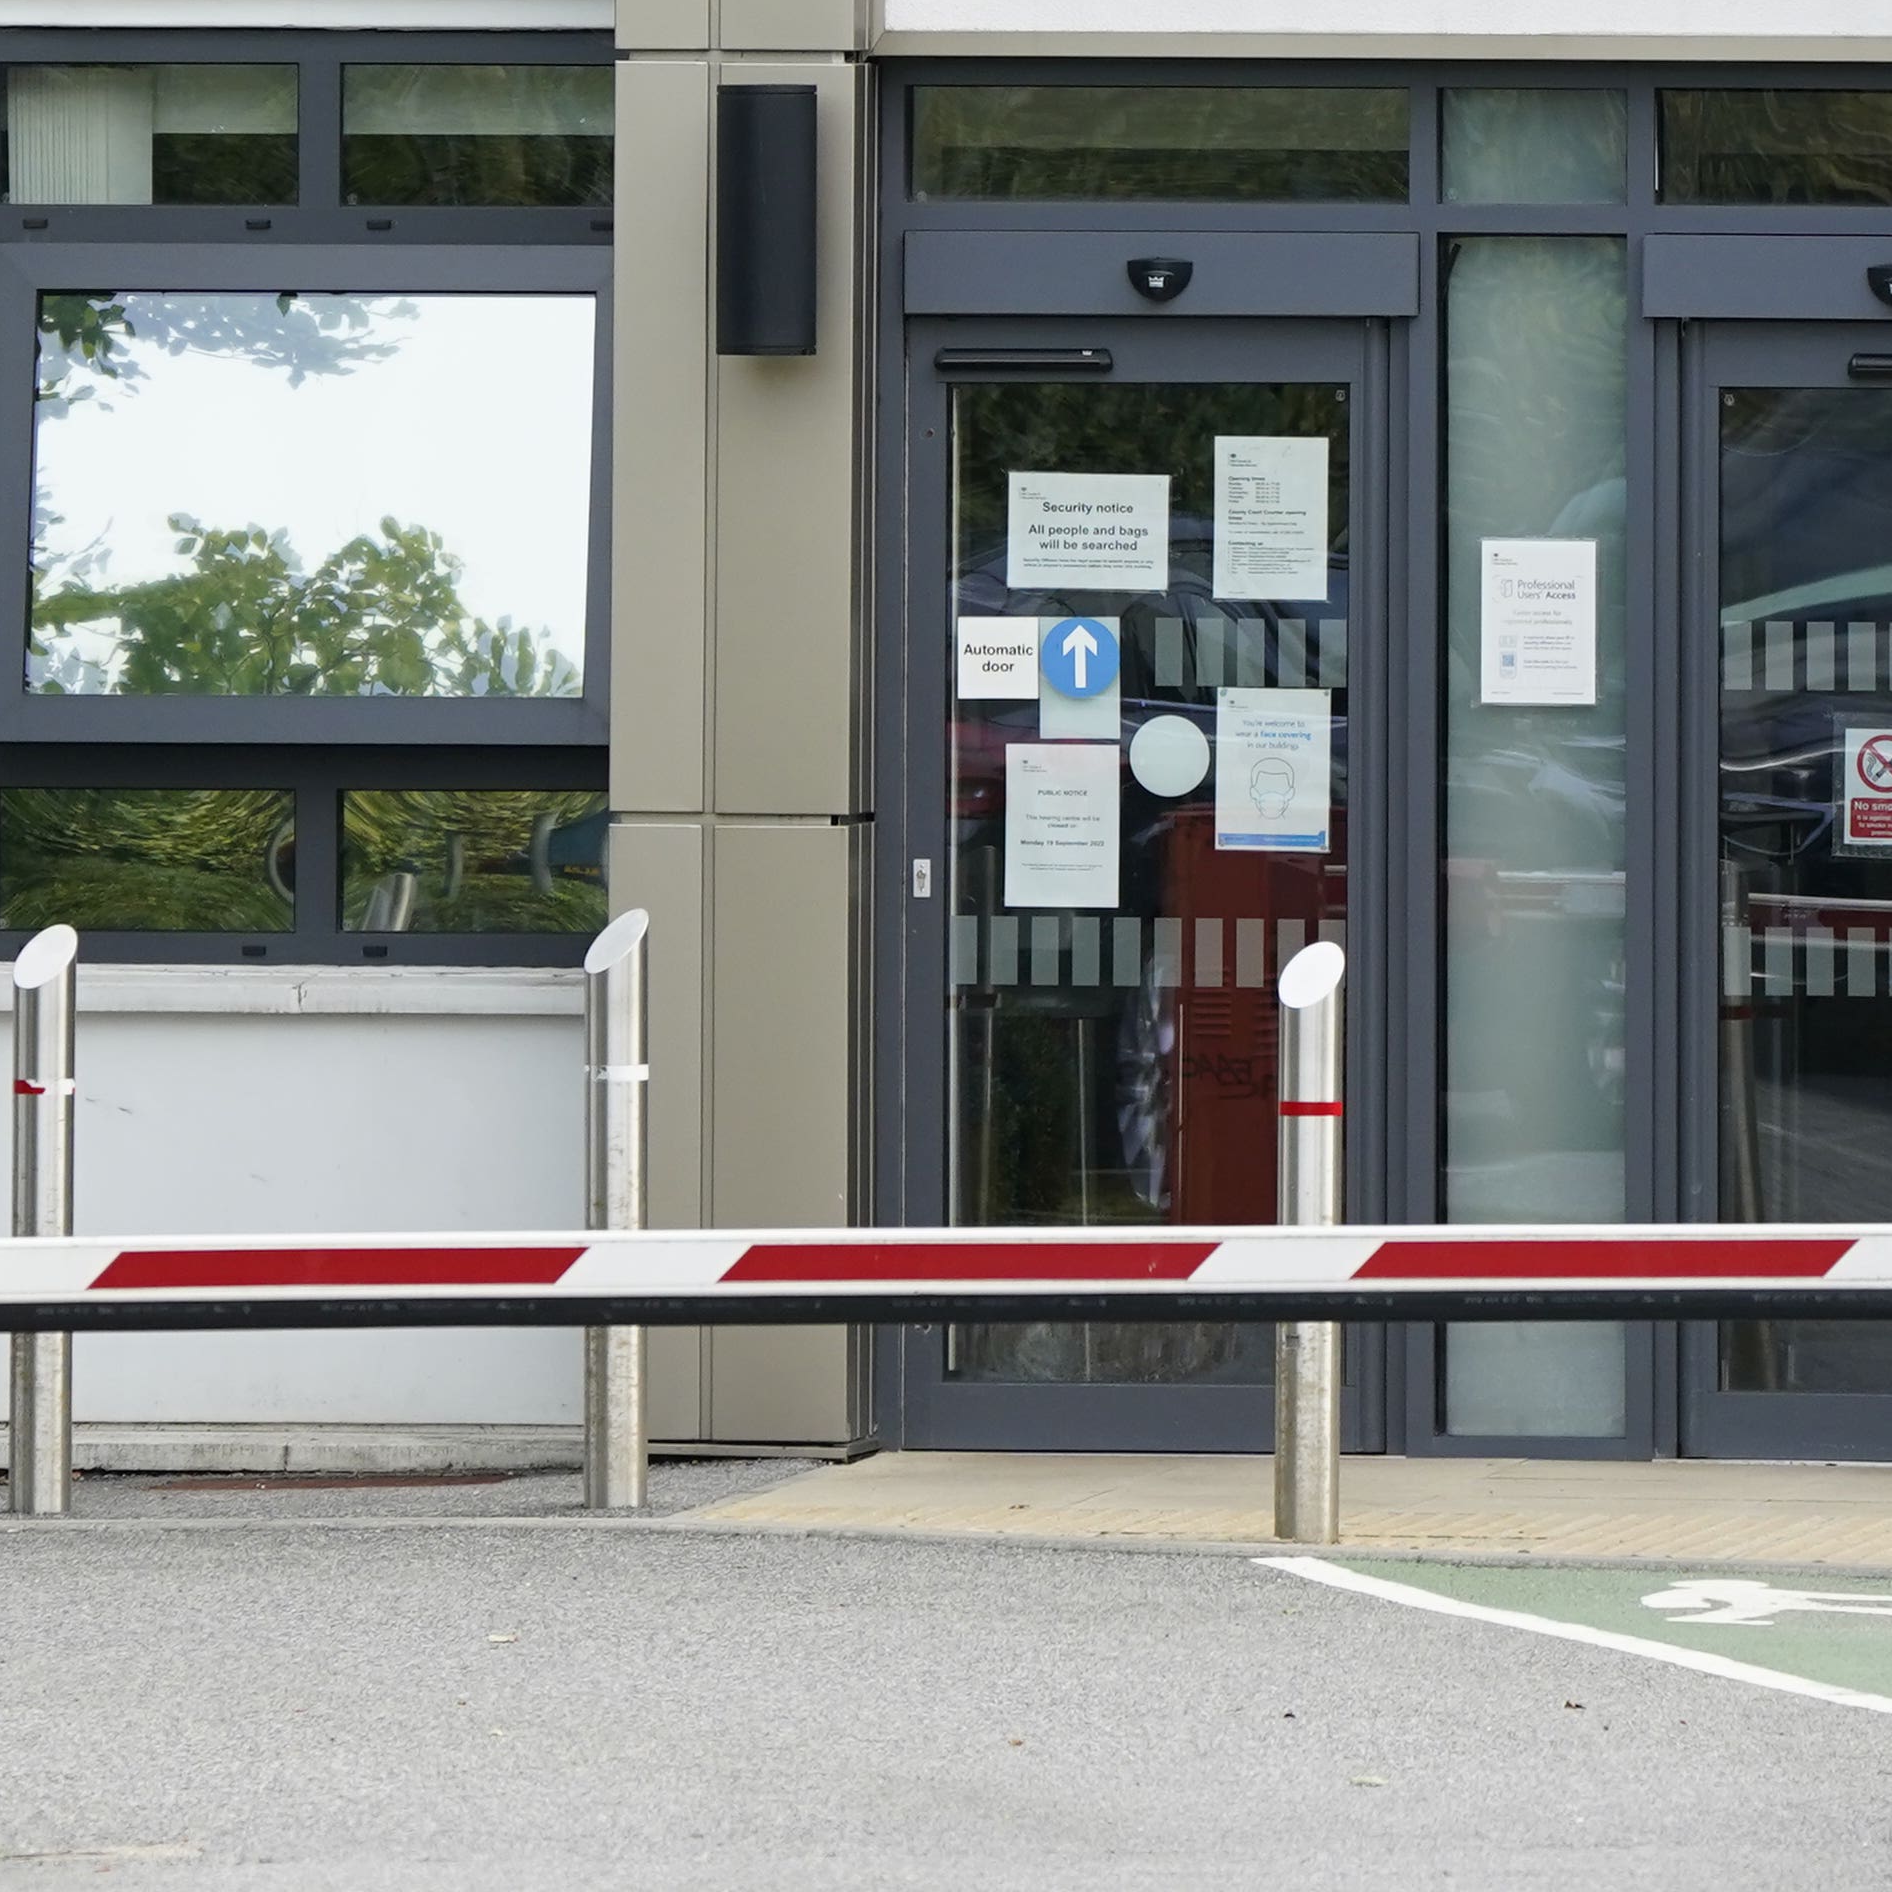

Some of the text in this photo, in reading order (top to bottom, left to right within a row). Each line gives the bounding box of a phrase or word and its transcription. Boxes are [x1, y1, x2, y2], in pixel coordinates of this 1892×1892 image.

[1042, 501, 1134, 515] Security notice
[1028, 524, 1149, 538] All people and bags
[1039, 540, 1138, 551] will be searched
[1517, 579, 1575, 590] Professional
[1545, 591, 1576, 600] Access
[964, 643, 1033, 656] Automatic
[982, 660, 1015, 672] door
[1278, 731, 1312, 740] covering
[1853, 801, 1869, 811] No
